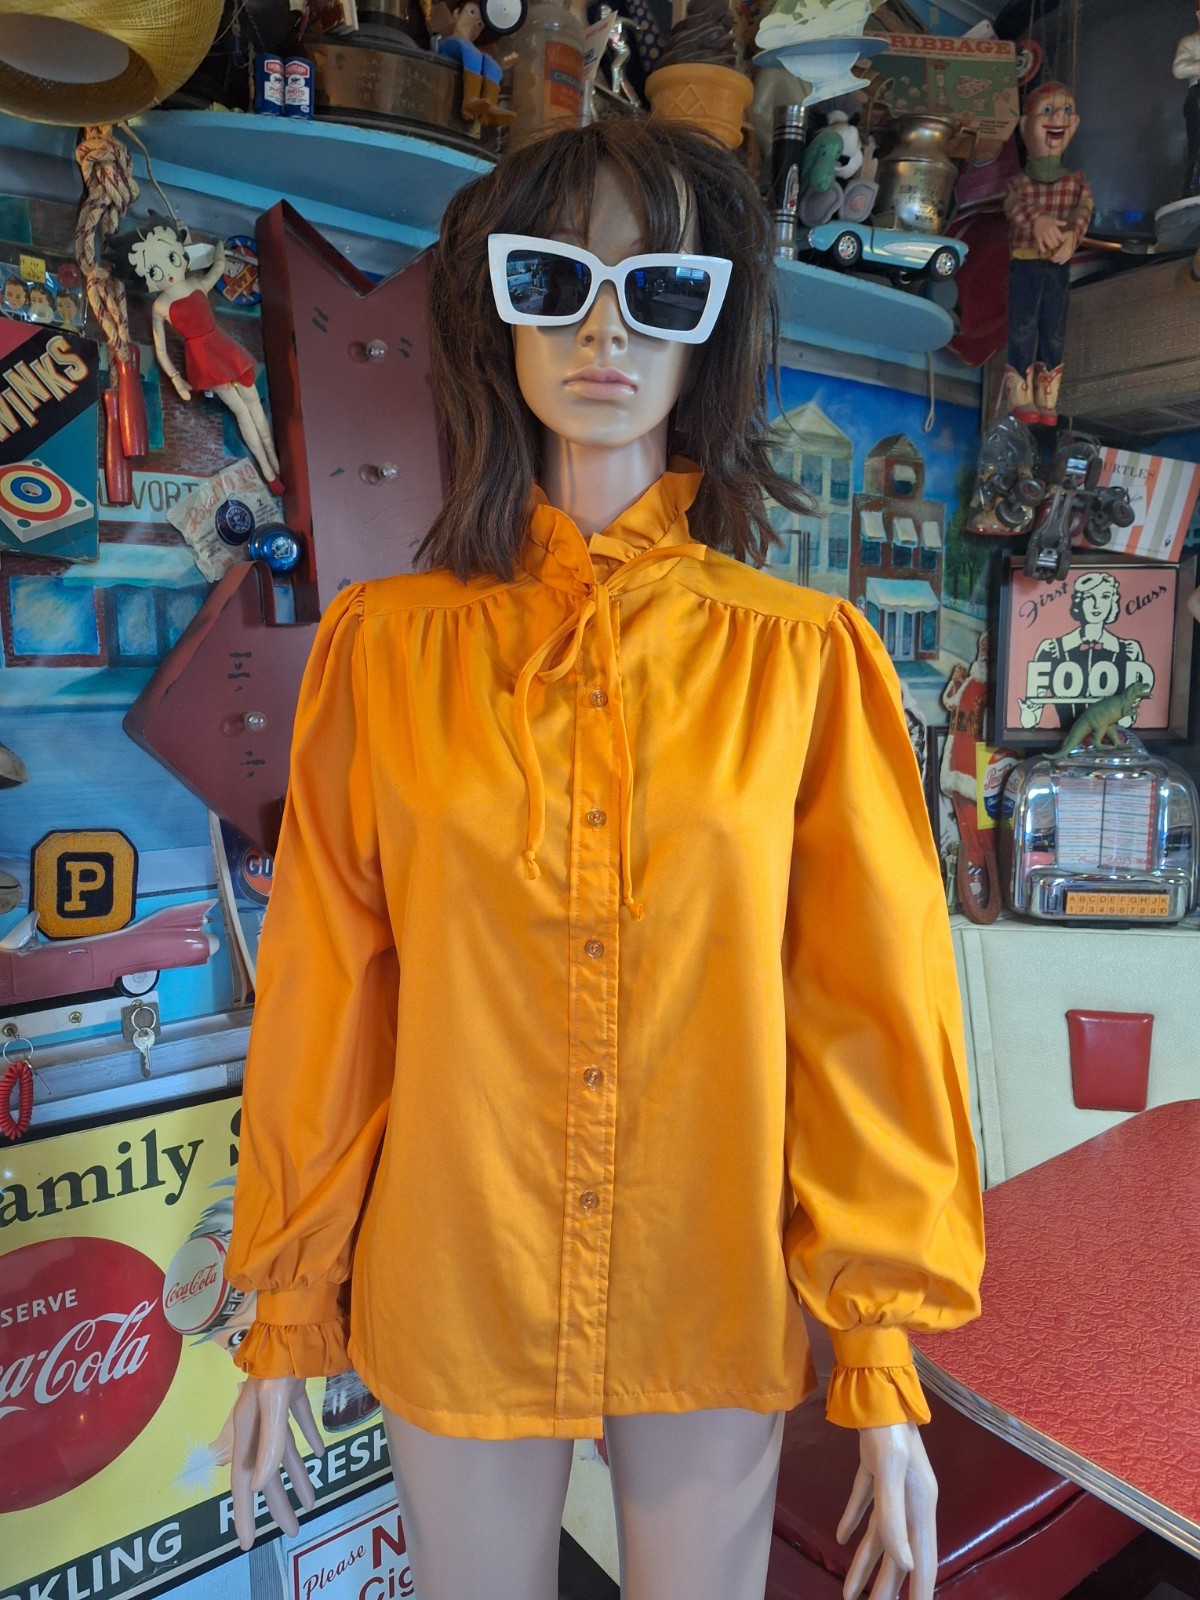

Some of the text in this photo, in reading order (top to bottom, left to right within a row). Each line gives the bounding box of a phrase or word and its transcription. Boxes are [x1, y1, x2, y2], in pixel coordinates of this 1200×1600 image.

[873, 33, 1012, 55] RIBBAGE
[1018, 581, 1069, 629] First
[1125, 584, 1167, 616] Class
[1027, 660, 1155, 698] FOOD
[64, 861, 106, 912] P
[0, 1128, 204, 1228] amily
[1, 1288, 78, 1328] SERVE
[0, 1522, 182, 1600] KLING
[303, 1545, 367, 1600] Please
